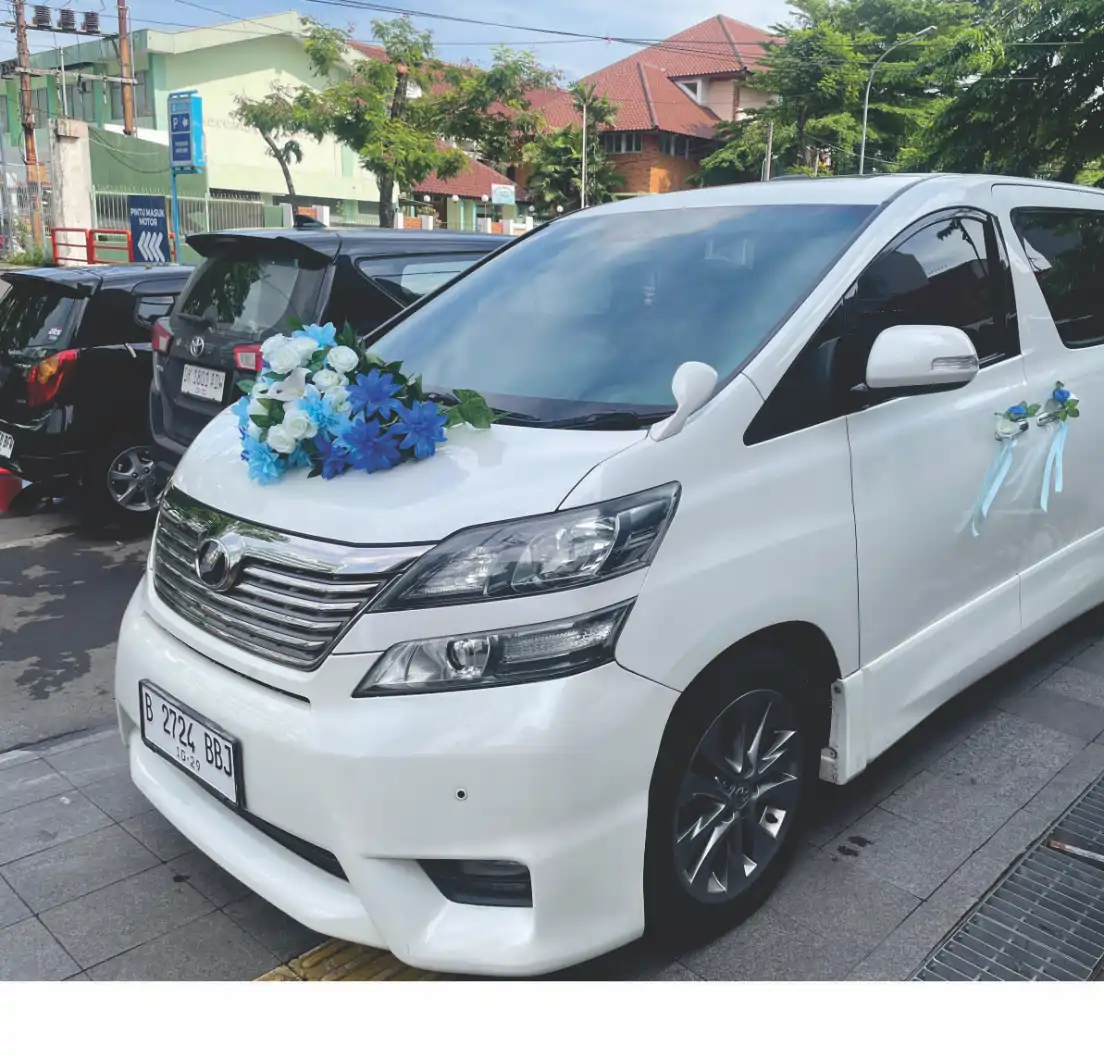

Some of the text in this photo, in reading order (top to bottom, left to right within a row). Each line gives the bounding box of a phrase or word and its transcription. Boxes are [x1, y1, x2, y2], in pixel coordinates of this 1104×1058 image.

[130, 207, 165, 217] PINTU MASUK
[139, 217, 158, 227] MOTOR
[145, 692, 232, 777] B 2724 BBJ
